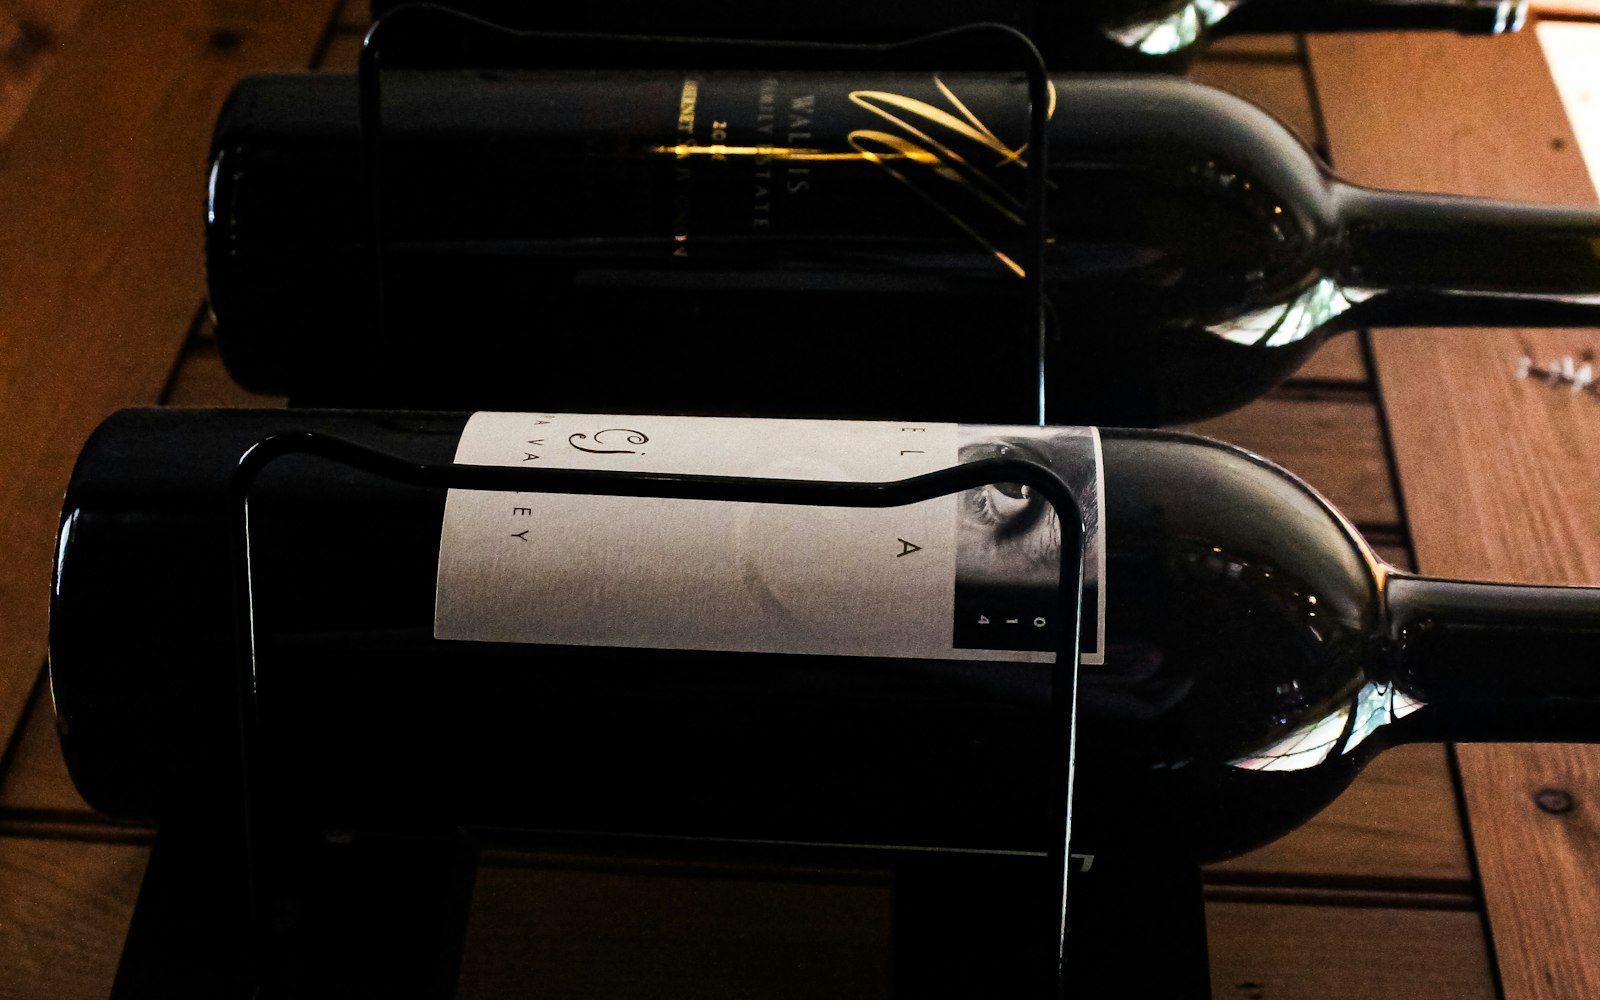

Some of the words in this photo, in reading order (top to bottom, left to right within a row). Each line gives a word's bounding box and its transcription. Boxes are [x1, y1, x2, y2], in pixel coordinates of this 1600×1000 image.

[710, 119, 729, 161] 20
[786, 94, 816, 194] WALIS
[510, 439, 545, 542] VAEY
[896, 427, 926, 558] ELA
